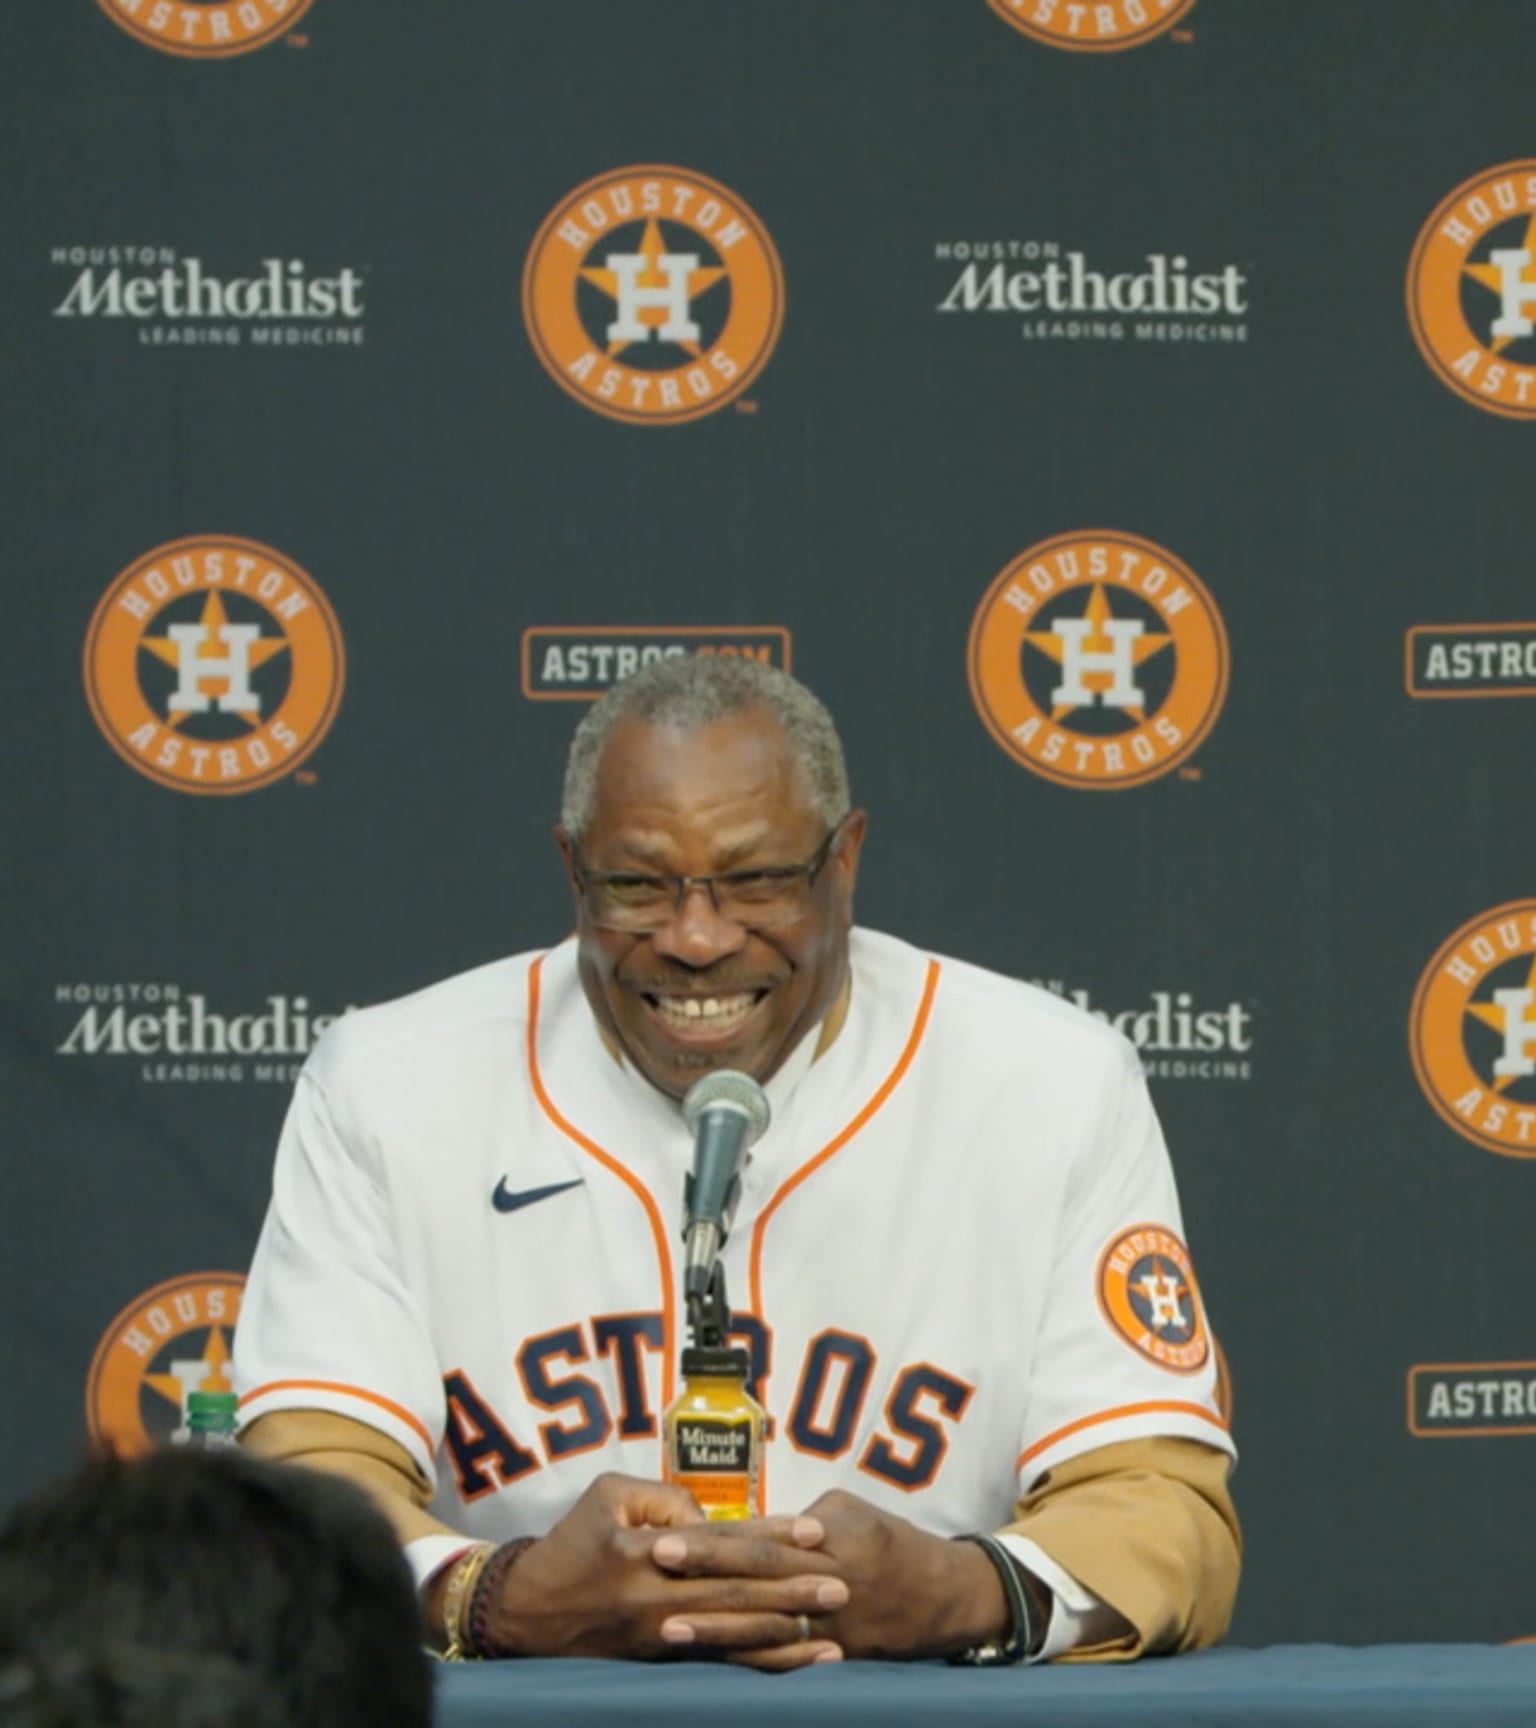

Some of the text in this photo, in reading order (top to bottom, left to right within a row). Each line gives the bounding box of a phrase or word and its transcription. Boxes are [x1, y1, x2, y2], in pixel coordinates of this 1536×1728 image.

[557, 182, 748, 251] HOUSTON
[52, 247, 176, 265] HOUSTON
[935, 242, 1060, 259] HOUSTON
[52, 257, 365, 318] Methodist
[605, 253, 699, 342] H
[935, 252, 1249, 314] Methodist
[138, 326, 365, 345] LEADING MEDICINE
[1023, 321, 1248, 341] LEADING MEDICINE
[568, 350, 739, 408] ASTROS
[119, 552, 308, 620] HOUSTON
[1003, 546, 1193, 615] HOUSTON
[167, 623, 260, 712] H
[1051, 618, 1145, 706] H
[128, 721, 298, 778] ASTROS
[1013, 716, 1182, 772] ASTROS
[56, 984, 181, 1002] HOUSTON
[142, 1064, 243, 1082] LEADING
[121, 1289, 226, 1357] HOUS
[1140, 1274, 1187, 1326] H
[681, 1427, 745, 1446] Minute
[690, 1446, 737, 1465] Maid
